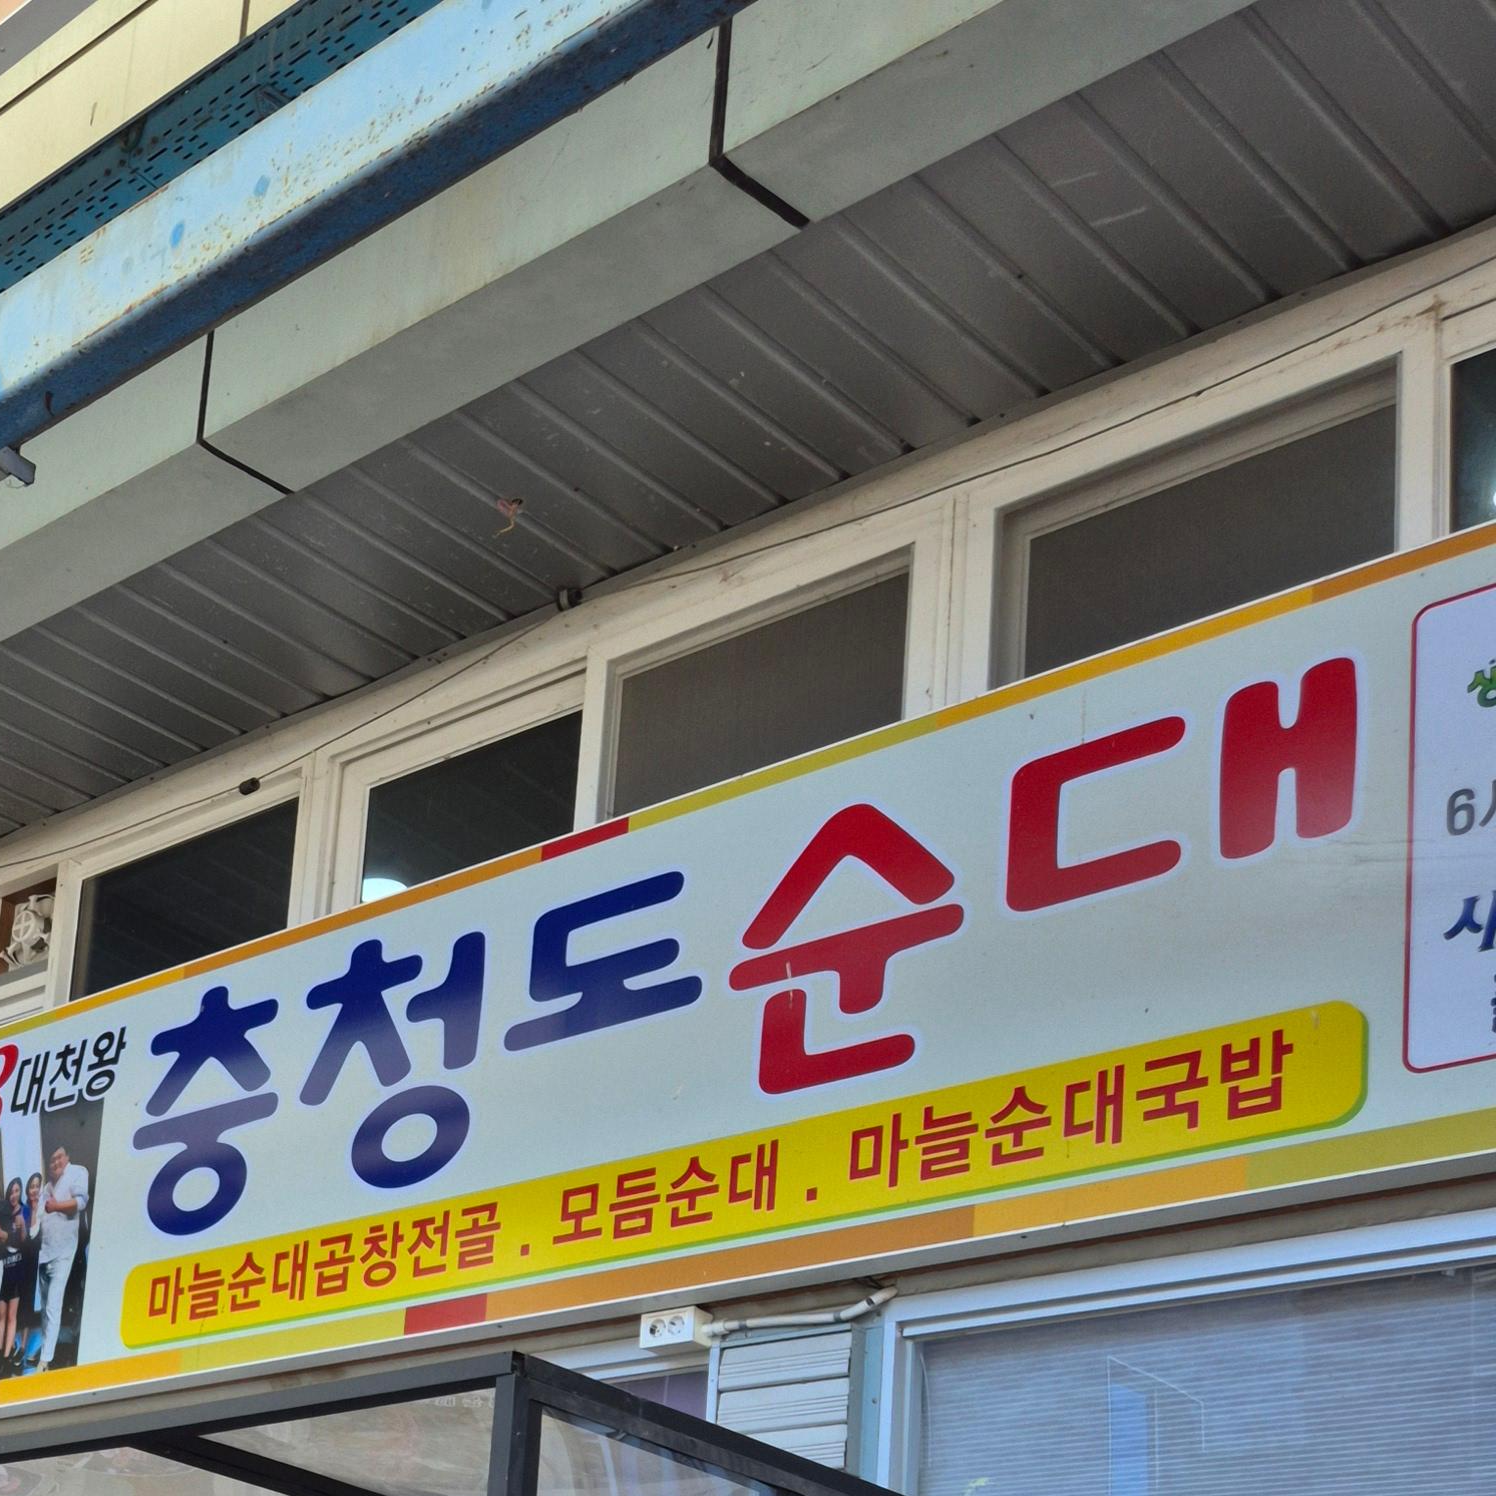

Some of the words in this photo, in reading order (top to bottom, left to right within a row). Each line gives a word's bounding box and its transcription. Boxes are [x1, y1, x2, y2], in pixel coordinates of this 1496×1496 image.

[132, 656, 1358, 1236] 충청도순대
[147, 1200, 501, 1325] 마늘순대곱창전골
[552, 1139, 779, 1246] 모듬순대
[849, 1029, 1294, 1188] 마늘순대국밥
